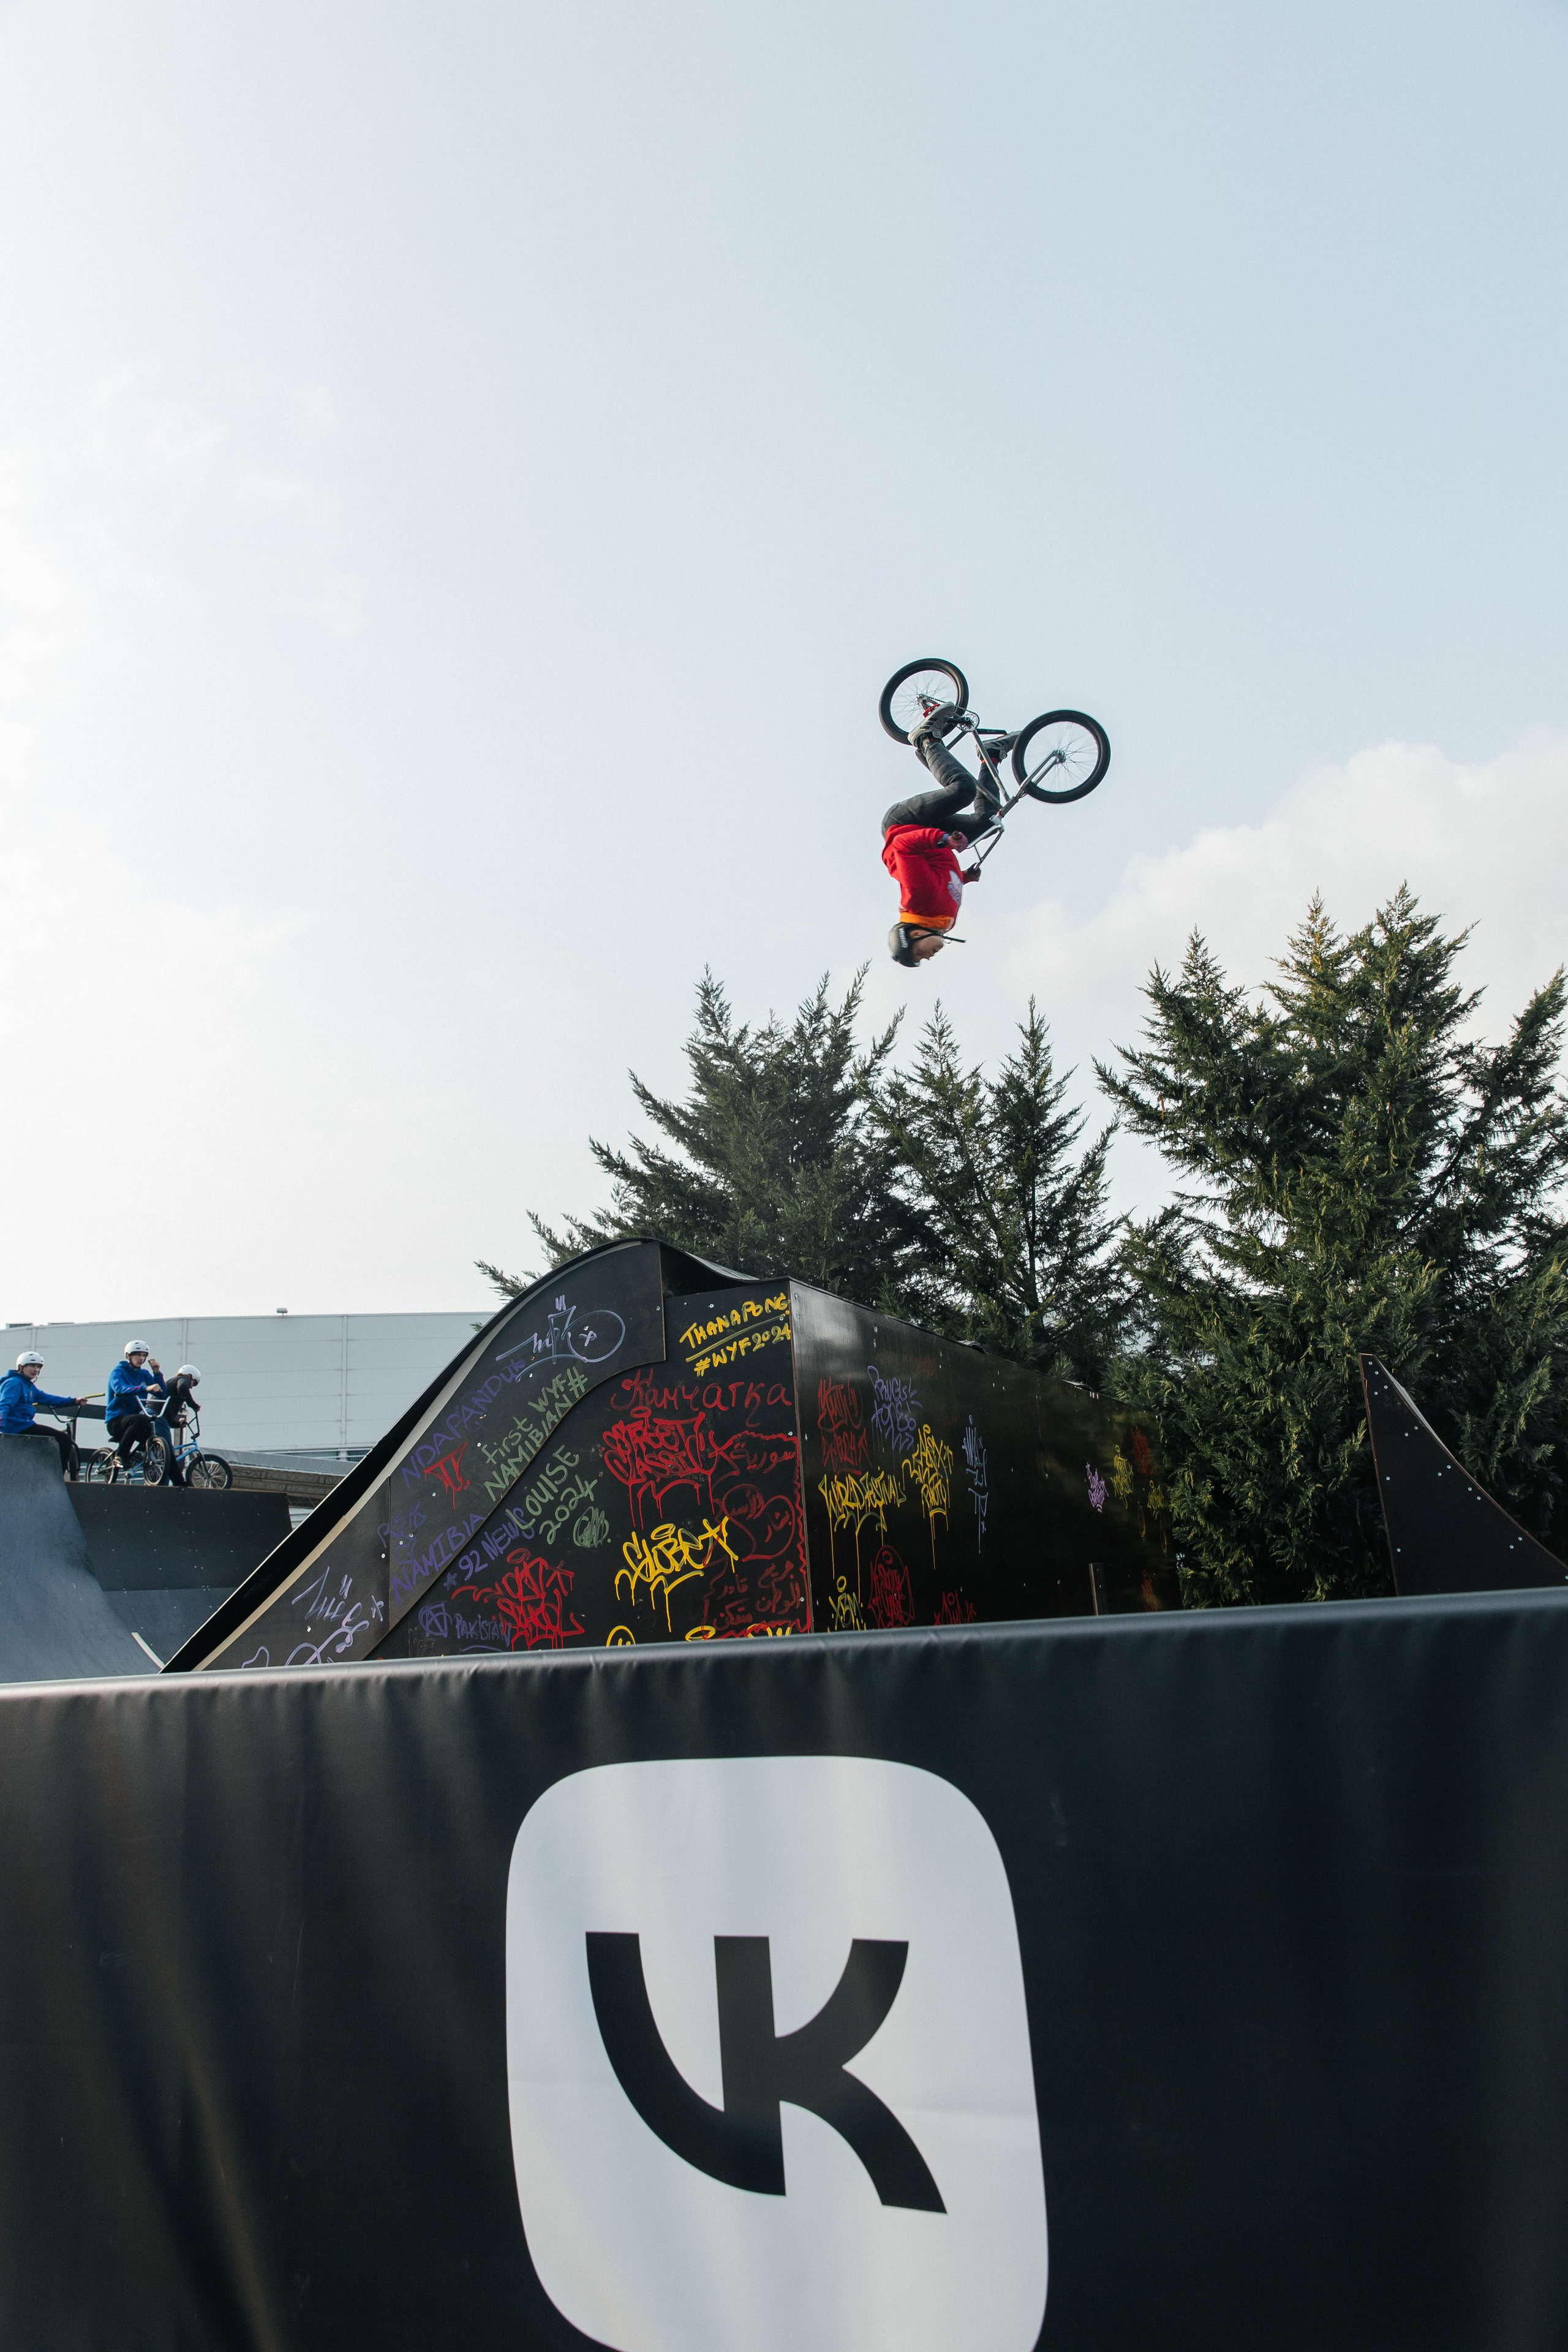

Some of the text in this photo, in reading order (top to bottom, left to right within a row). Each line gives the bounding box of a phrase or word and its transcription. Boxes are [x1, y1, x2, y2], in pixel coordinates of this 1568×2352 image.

[679, 1292, 791, 1349] THANAPONG
[693, 1322, 791, 1377] #WYF2024
[483, 1393, 573, 1501] NAMIBIAN
[505, 1444, 579, 1529] LOUISE
[539, 1474, 598, 1545] 2024
[390, 1512, 486, 1605] NAMIBIA
[458, 1550, 488, 1581] 92
